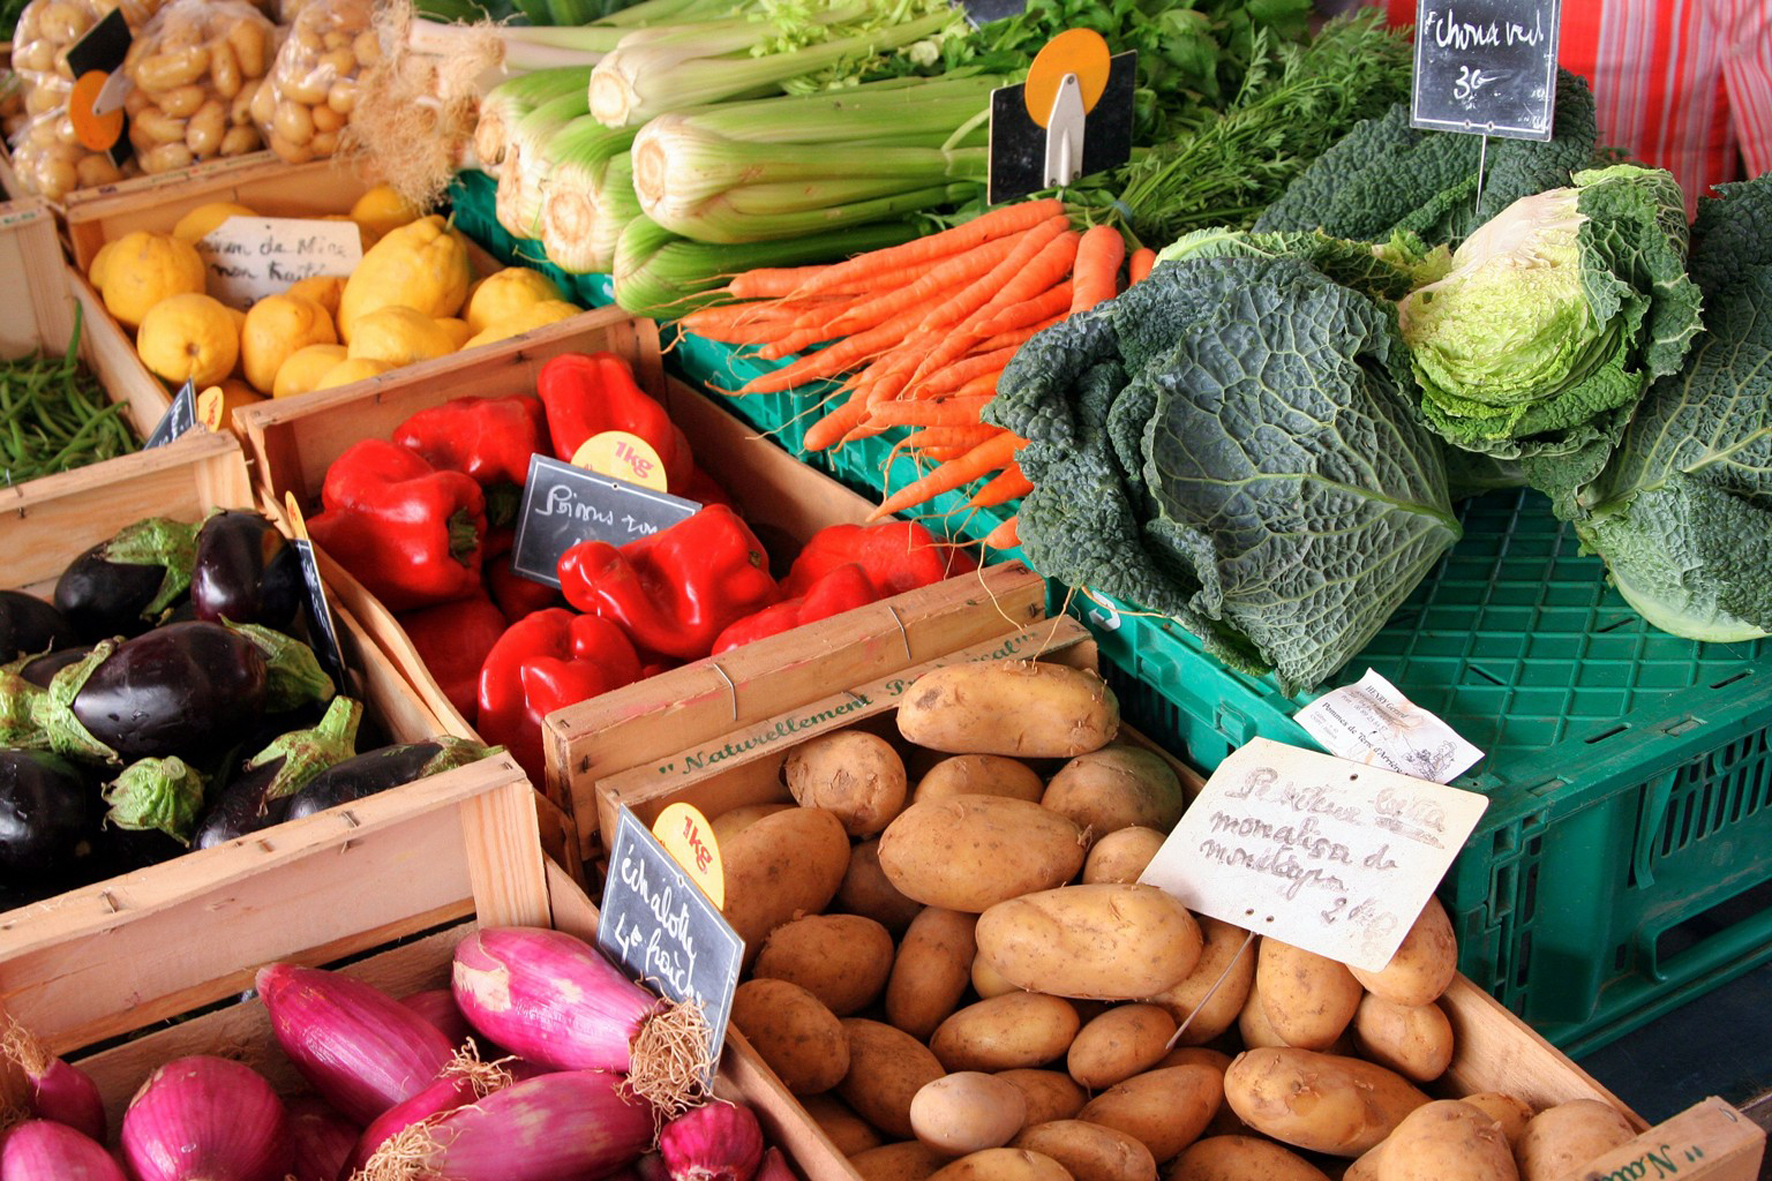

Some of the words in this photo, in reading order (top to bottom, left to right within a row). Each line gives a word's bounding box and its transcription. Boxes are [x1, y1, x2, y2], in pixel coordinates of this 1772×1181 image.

[617, 441, 653, 479] 1kg
[1321, 702, 1348, 727] Pommes
[1347, 725, 1358, 735] de
[1358, 731, 1374, 749] Terre
[684, 815, 713, 875] 1kg
